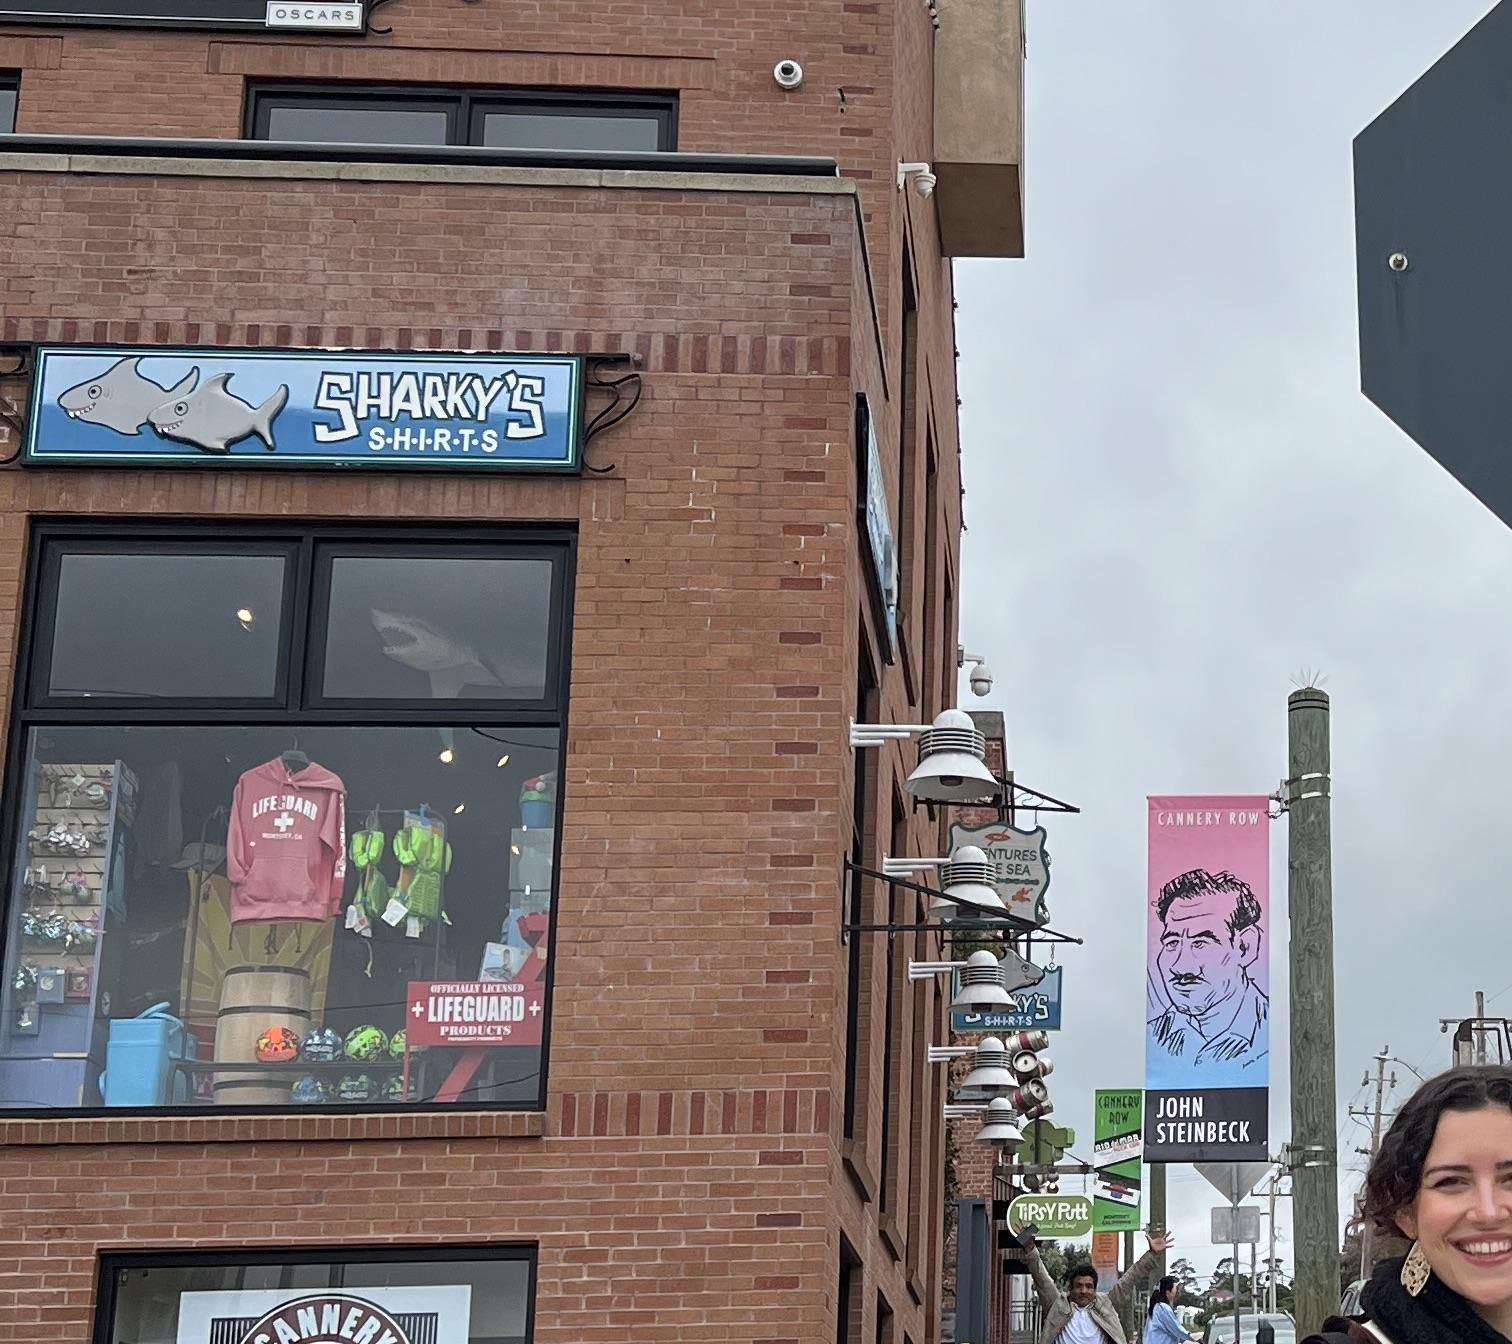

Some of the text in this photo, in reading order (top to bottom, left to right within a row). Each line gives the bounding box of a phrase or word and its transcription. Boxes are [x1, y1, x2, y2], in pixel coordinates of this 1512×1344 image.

[275, 8, 355, 22] OSCARS
[314, 369, 546, 443] SHARKY'S
[1157, 811, 1260, 826] CANNERY ROW
[981, 847, 1038, 862] ENTURES
[1006, 862, 1031, 876] SEA
[430, 983, 525, 994] OFFICIALLY LICENSED
[427, 995, 525, 1023] LIFEGUARD
[439, 1025, 513, 1037] PRODUCTS
[1098, 1095, 1140, 1109] CANNERY
[1156, 1096, 1204, 1119] JOHN
[1108, 1111, 1130, 1125] ROW
[1156, 1120, 1251, 1144] STEINBECK
